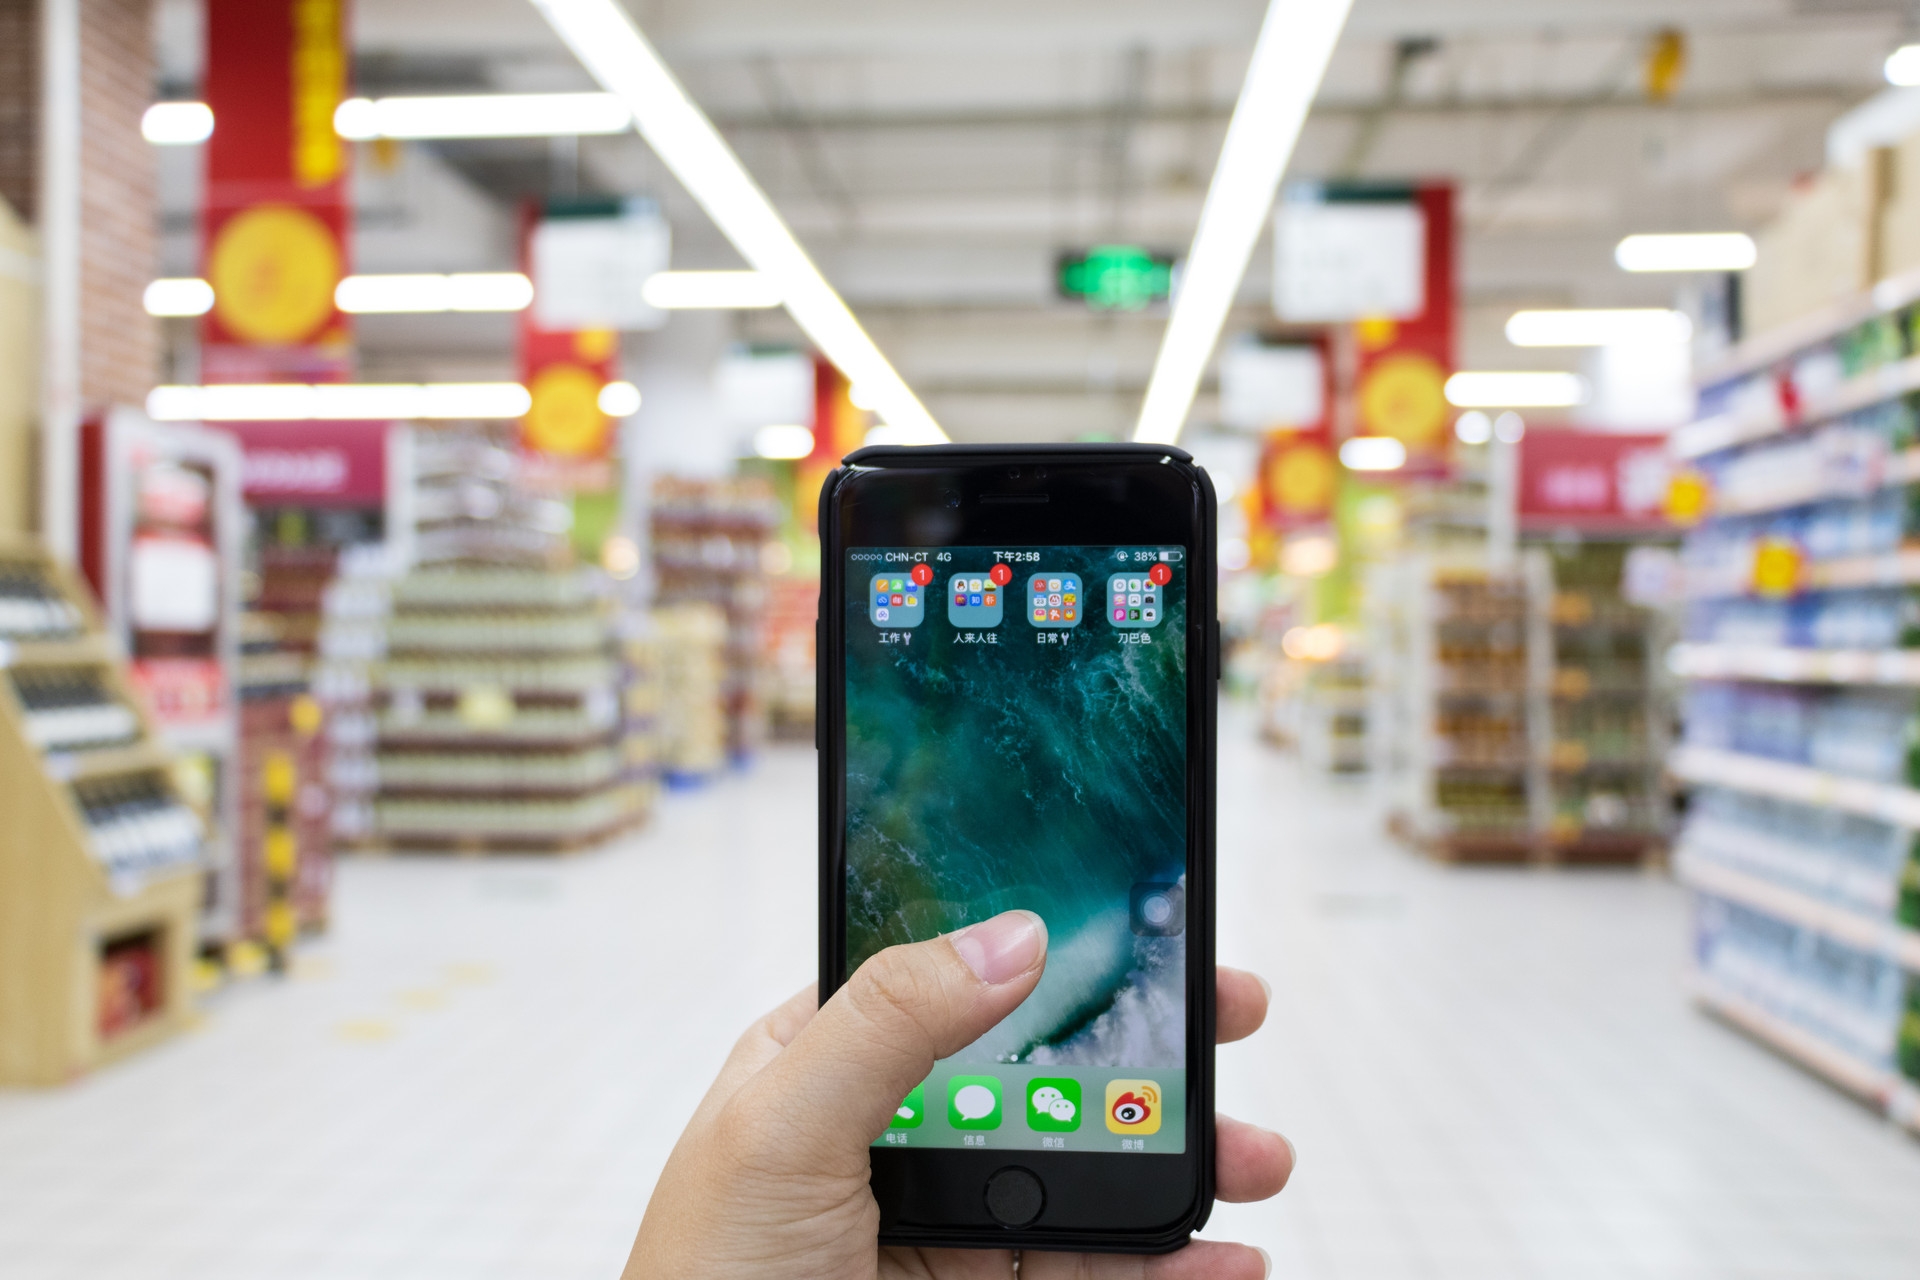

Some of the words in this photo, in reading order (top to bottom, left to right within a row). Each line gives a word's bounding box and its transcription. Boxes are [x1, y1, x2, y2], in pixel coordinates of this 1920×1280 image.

[885, 552, 929, 562] CHN-CT
[936, 552, 952, 562] 4G
[993, 551, 1041, 563] 下午2:58
[1134, 551, 1157, 561] 38%
[919, 569, 925, 581] 1
[998, 569, 1004, 581] 1
[1157, 568, 1163, 581] 1
[878, 632, 900, 644] 工作
[953, 632, 998, 644] 人来人往
[1037, 632, 1058, 644] 日常
[1118, 632, 1151, 644] 刀巴色
[885, 1132, 908, 1144] 电话
[963, 1134, 986, 1146] 信息
[1042, 1136, 1065, 1148] 微信
[1121, 1138, 1144, 1150] 微博
